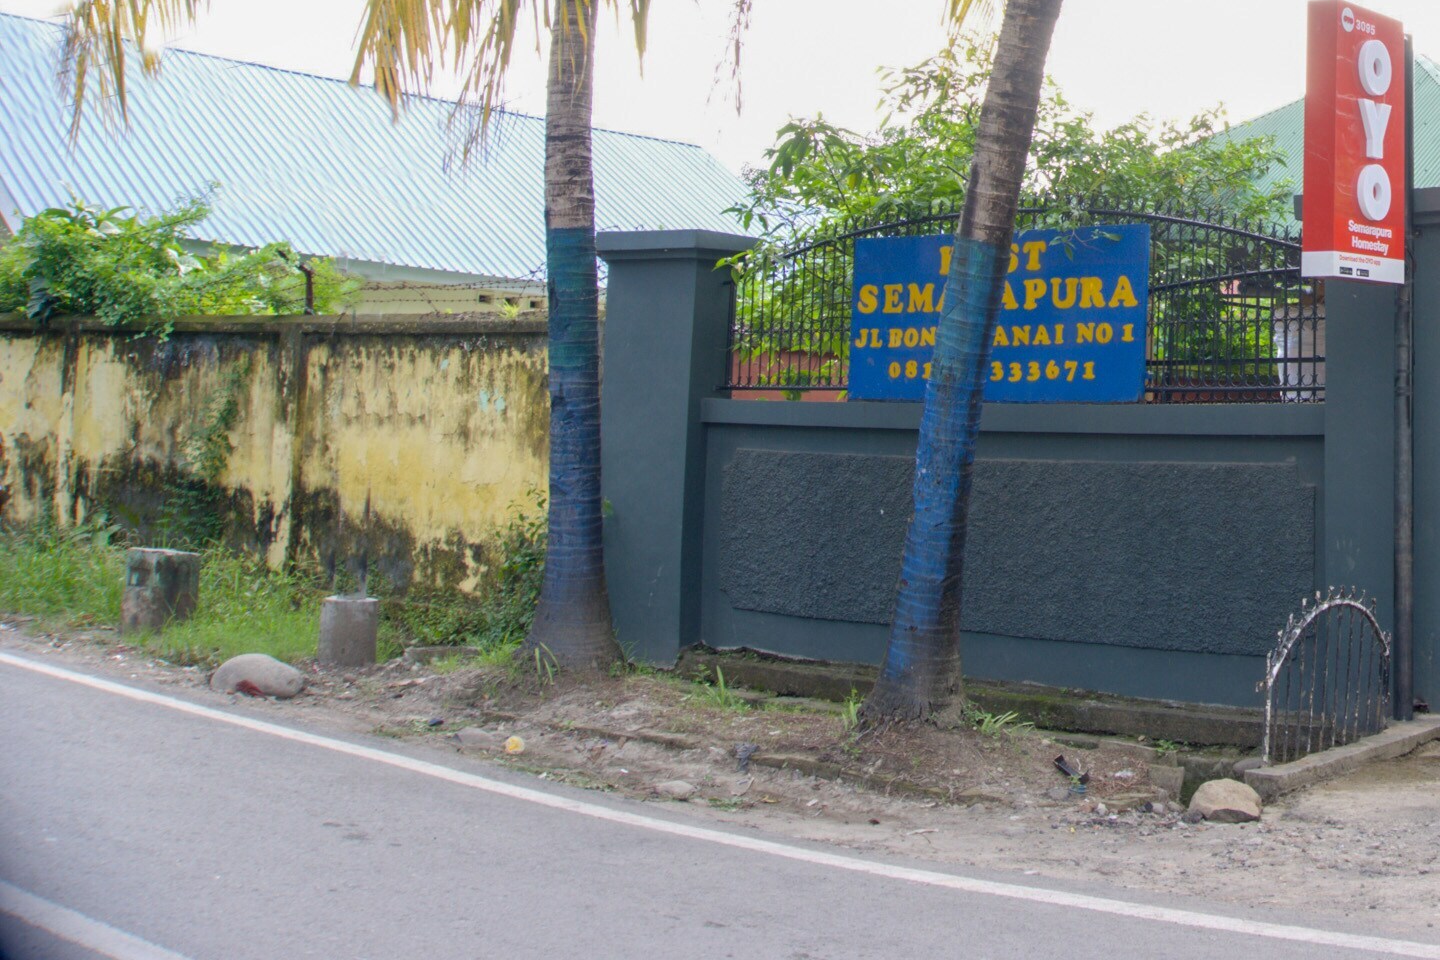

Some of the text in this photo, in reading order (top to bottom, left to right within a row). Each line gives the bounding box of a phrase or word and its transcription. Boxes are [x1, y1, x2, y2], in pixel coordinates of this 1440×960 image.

[1357, 40, 1392, 221] OYO
[1348, 219, 1392, 239] Semarapura
[1352, 235, 1389, 256] Homestay
[857, 275, 1139, 314] SEMAPURA
[855, 328, 883, 348] JL
[1076, 322, 1113, 344] NO
[1121, 323, 1134, 342] 1
